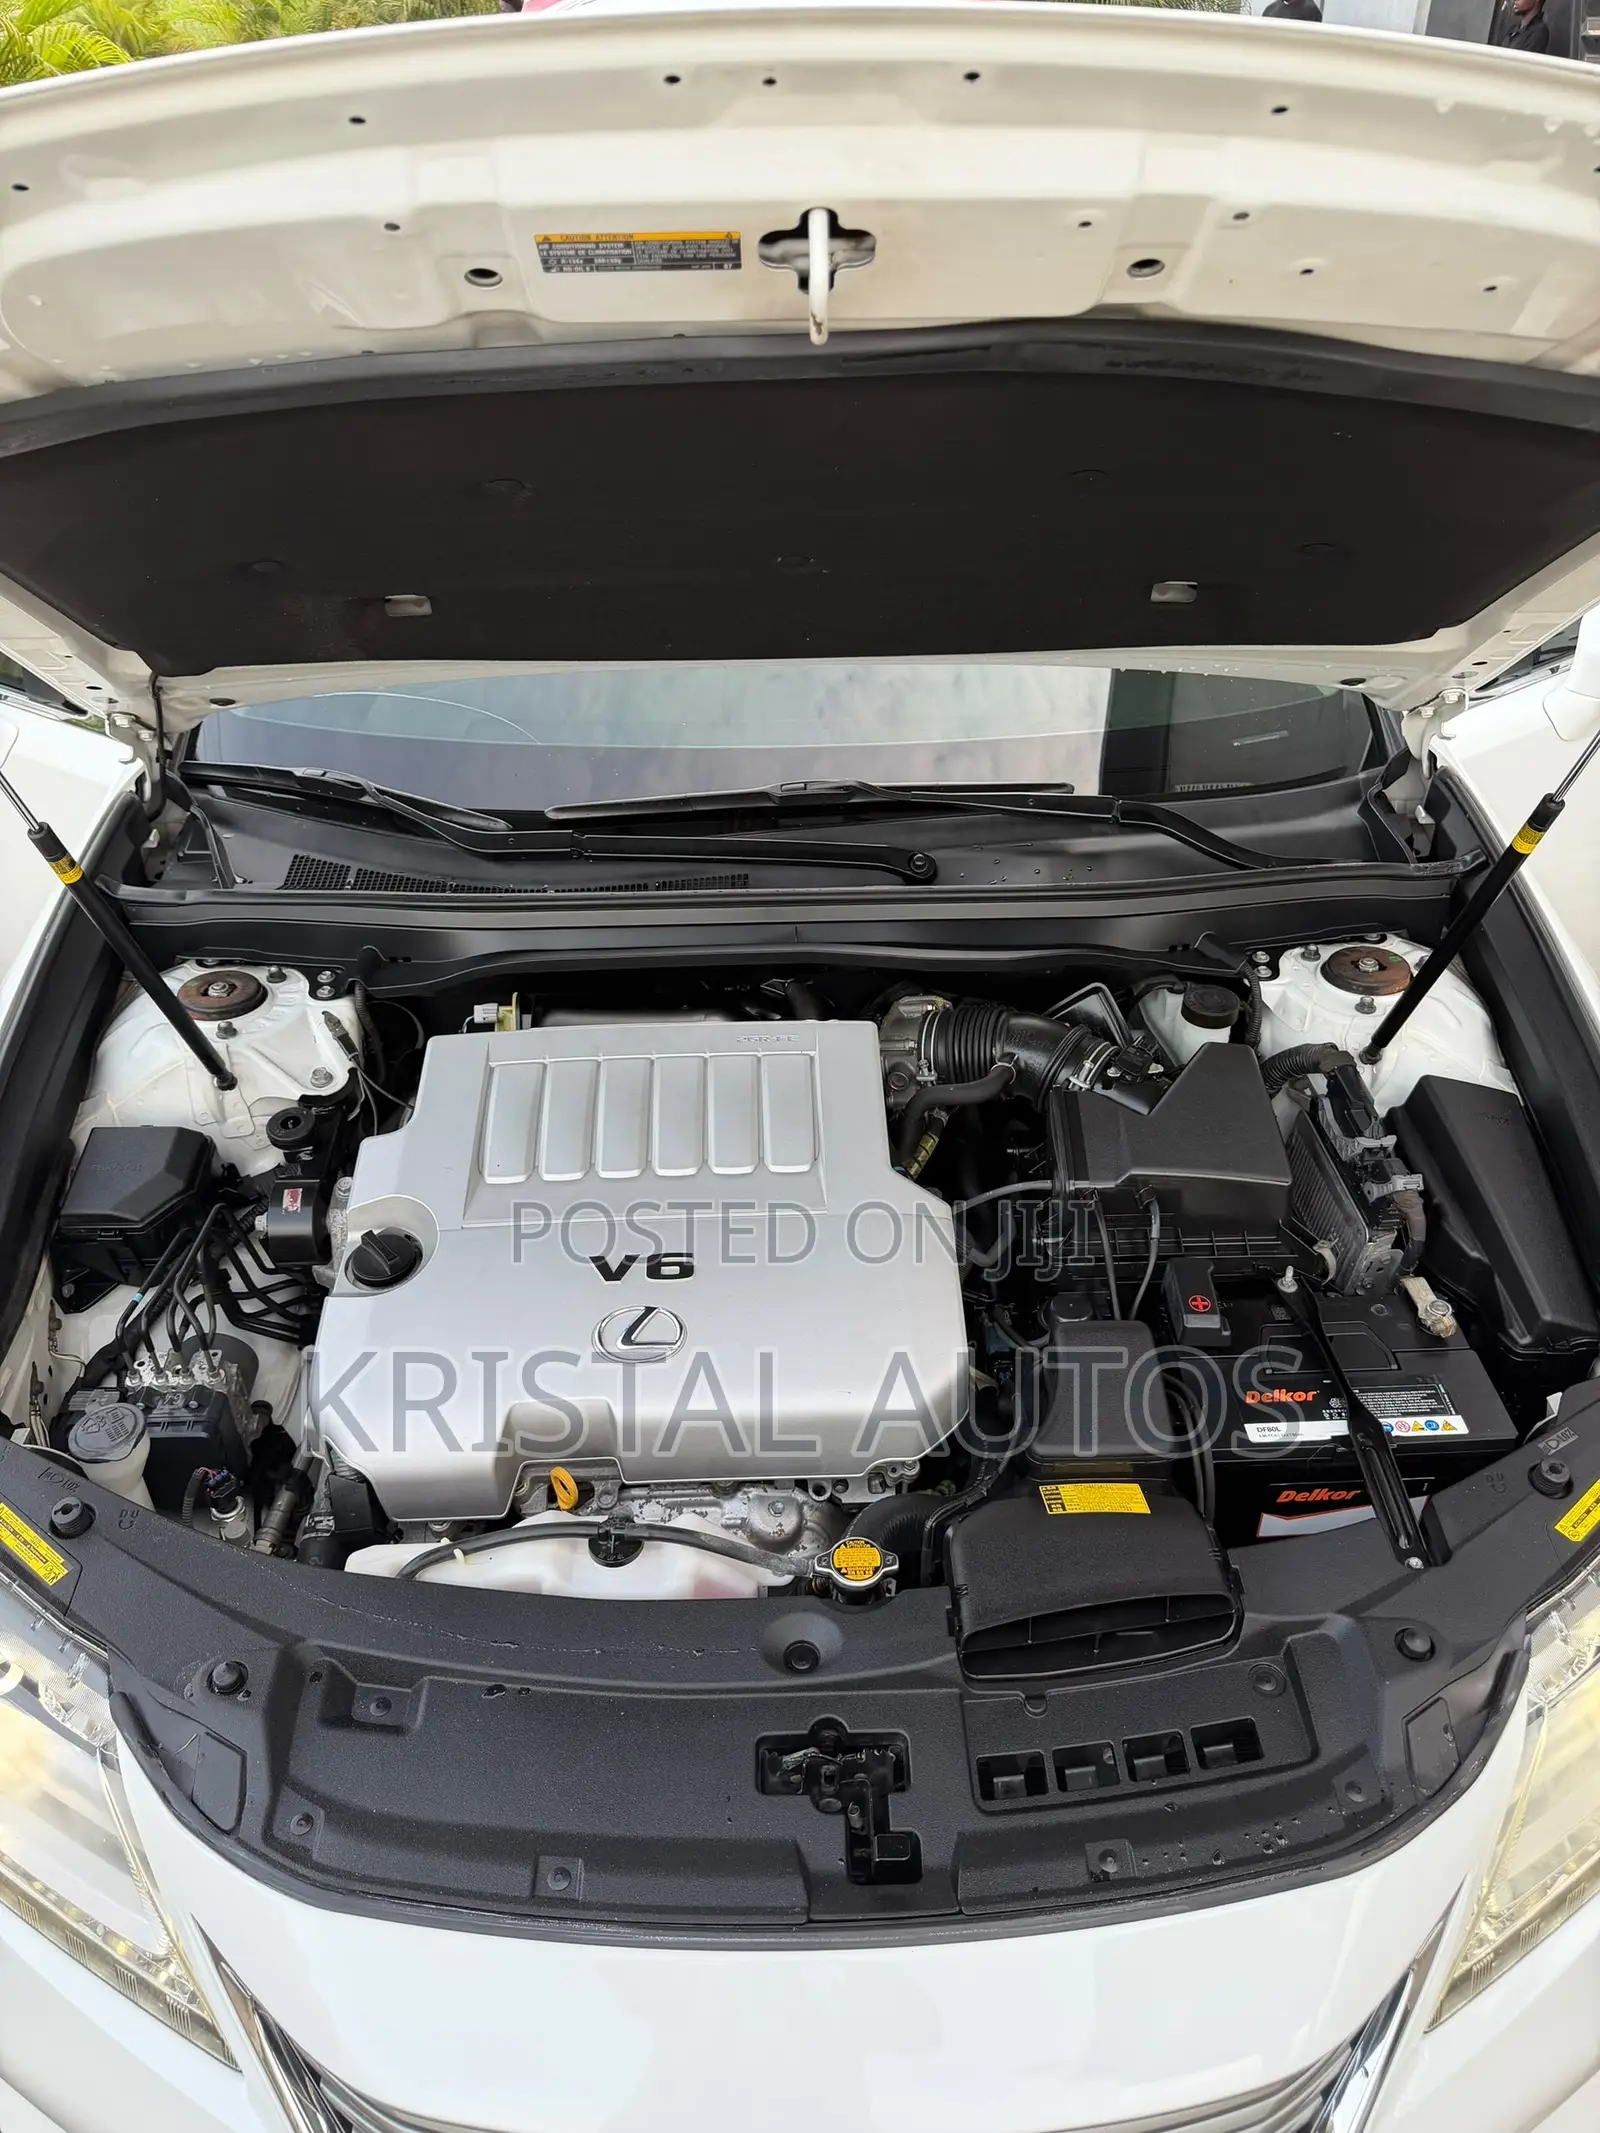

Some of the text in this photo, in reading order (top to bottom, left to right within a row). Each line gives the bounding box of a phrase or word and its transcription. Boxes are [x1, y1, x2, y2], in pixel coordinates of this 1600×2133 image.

[588, 1252, 695, 1284] V6
[1245, 1389, 1317, 1404] Delkor
[1275, 1488, 1361, 1503] Delkor
